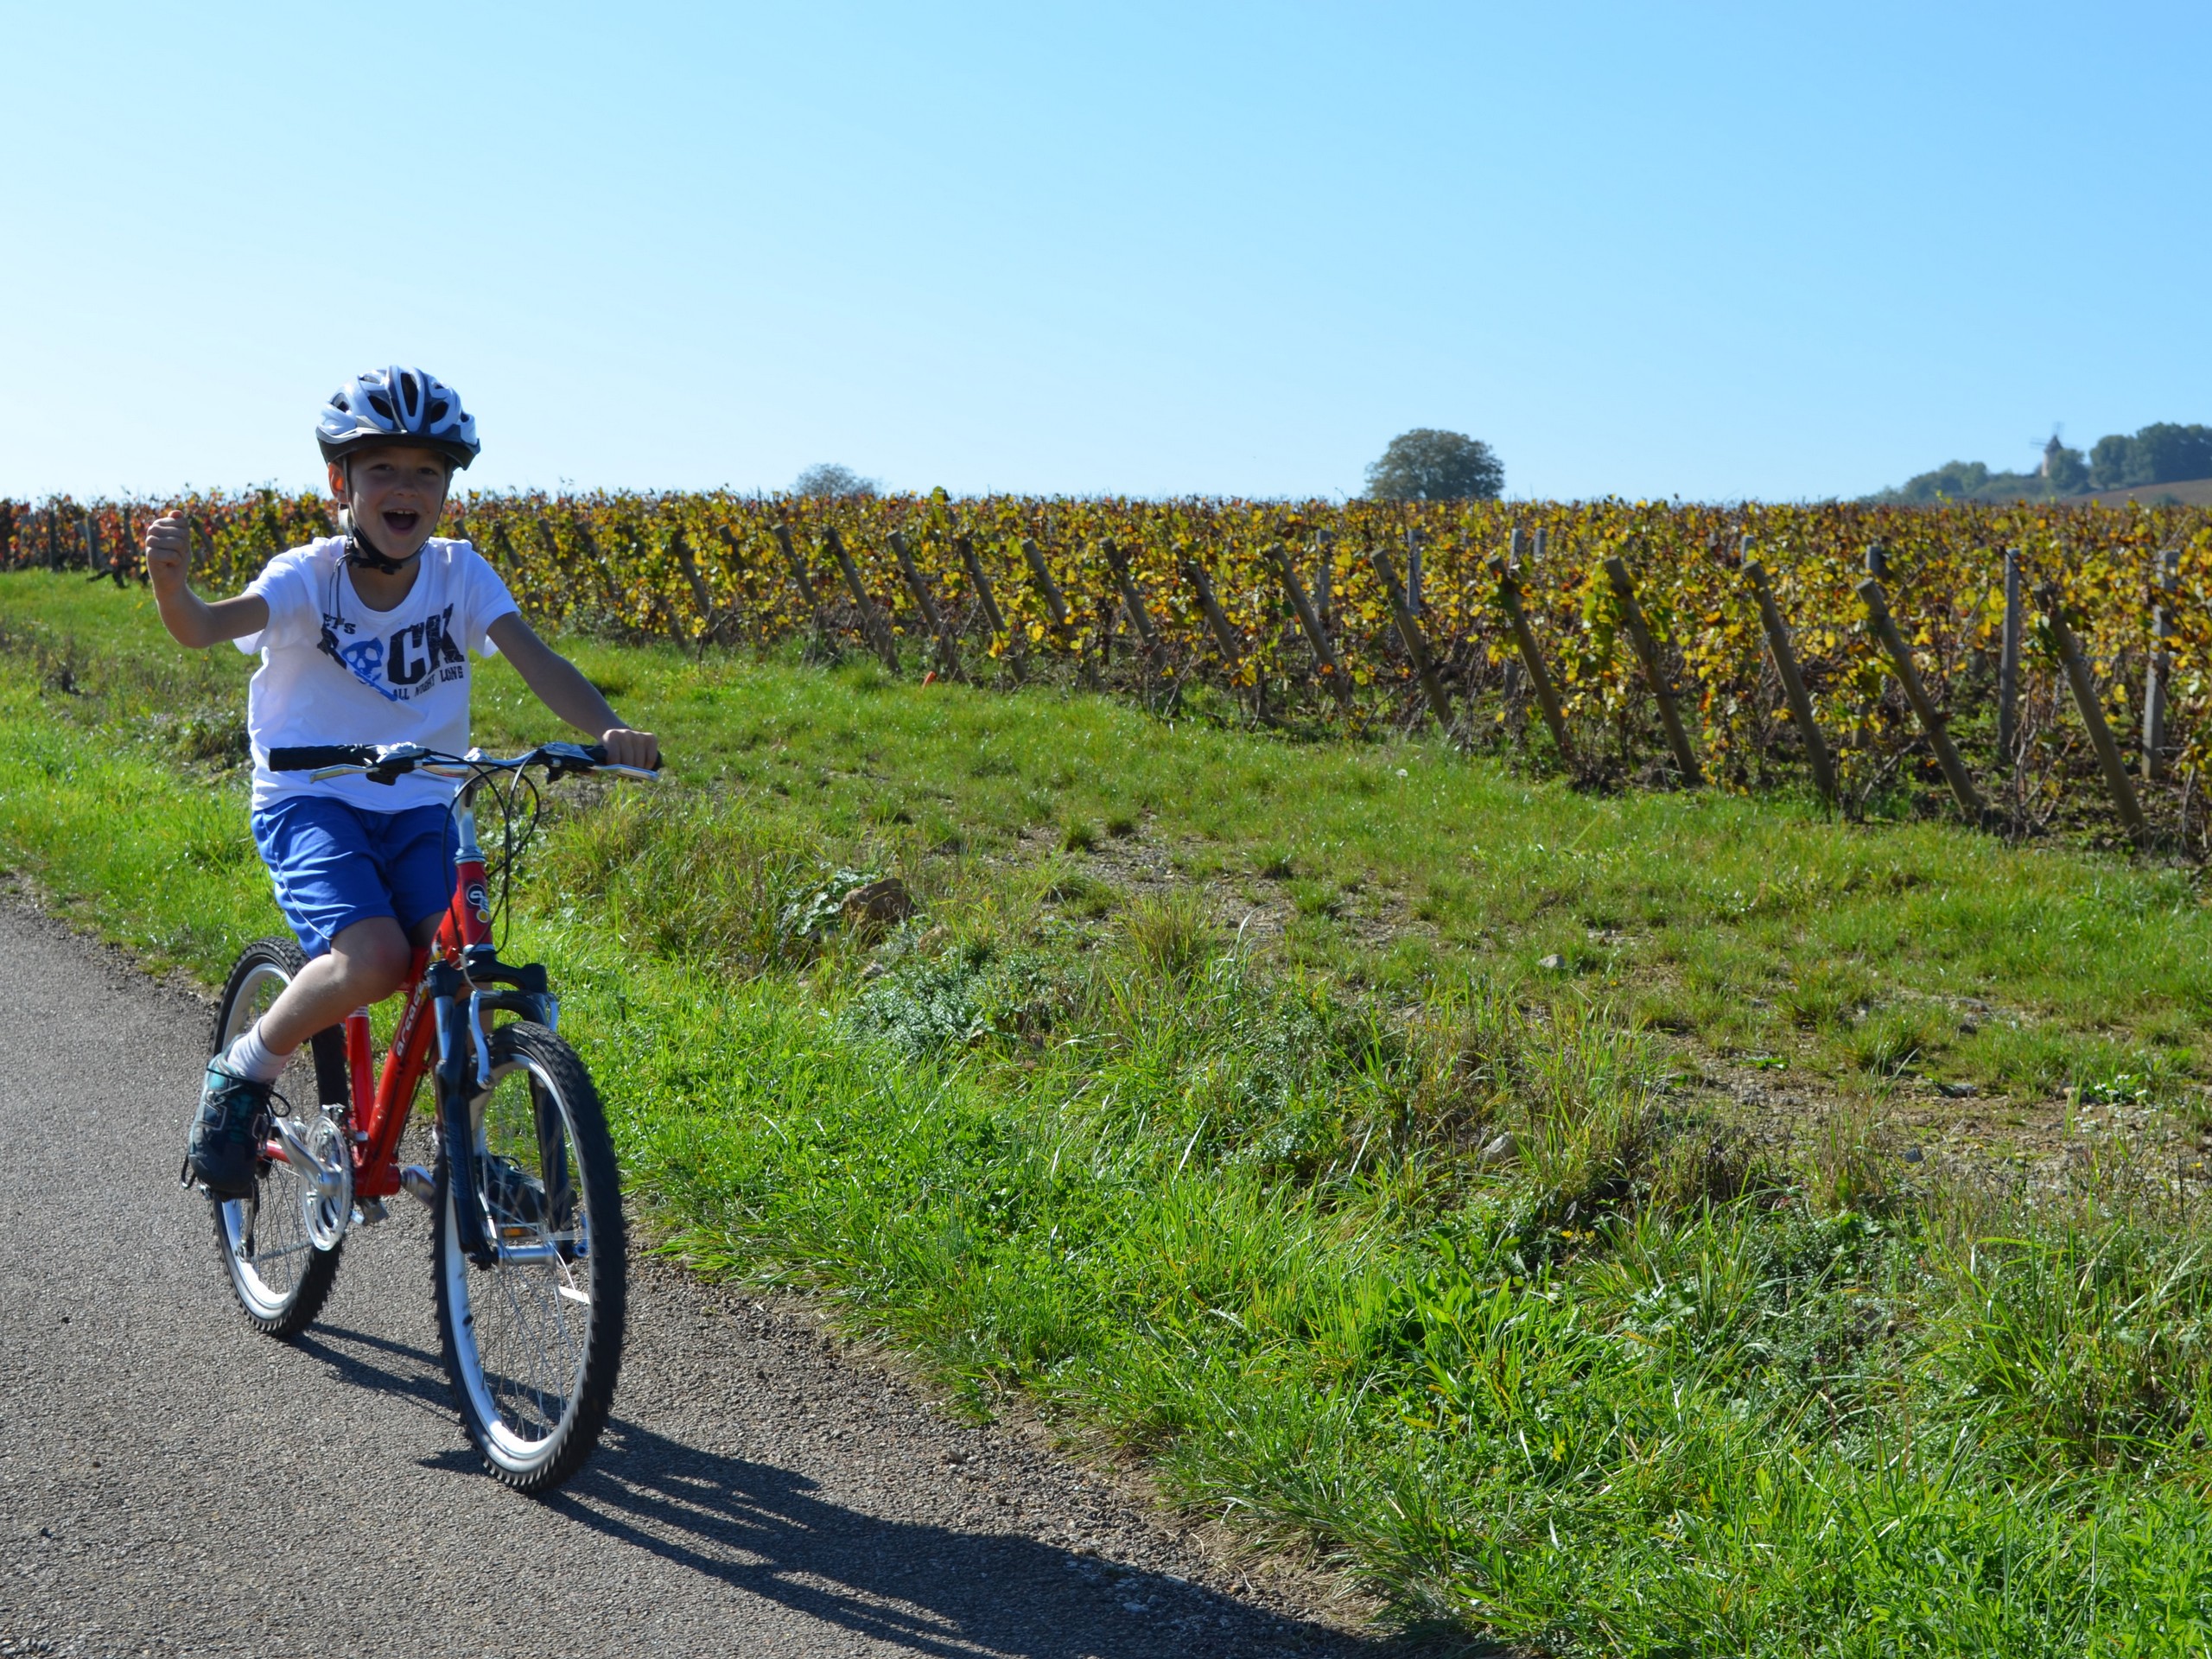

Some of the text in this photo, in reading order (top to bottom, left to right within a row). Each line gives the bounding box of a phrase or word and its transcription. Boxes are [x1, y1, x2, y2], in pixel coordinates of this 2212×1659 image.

[316, 603, 465, 685] RCK
[393, 688, 410, 701] ALL
[440, 665, 464, 683] LONG
